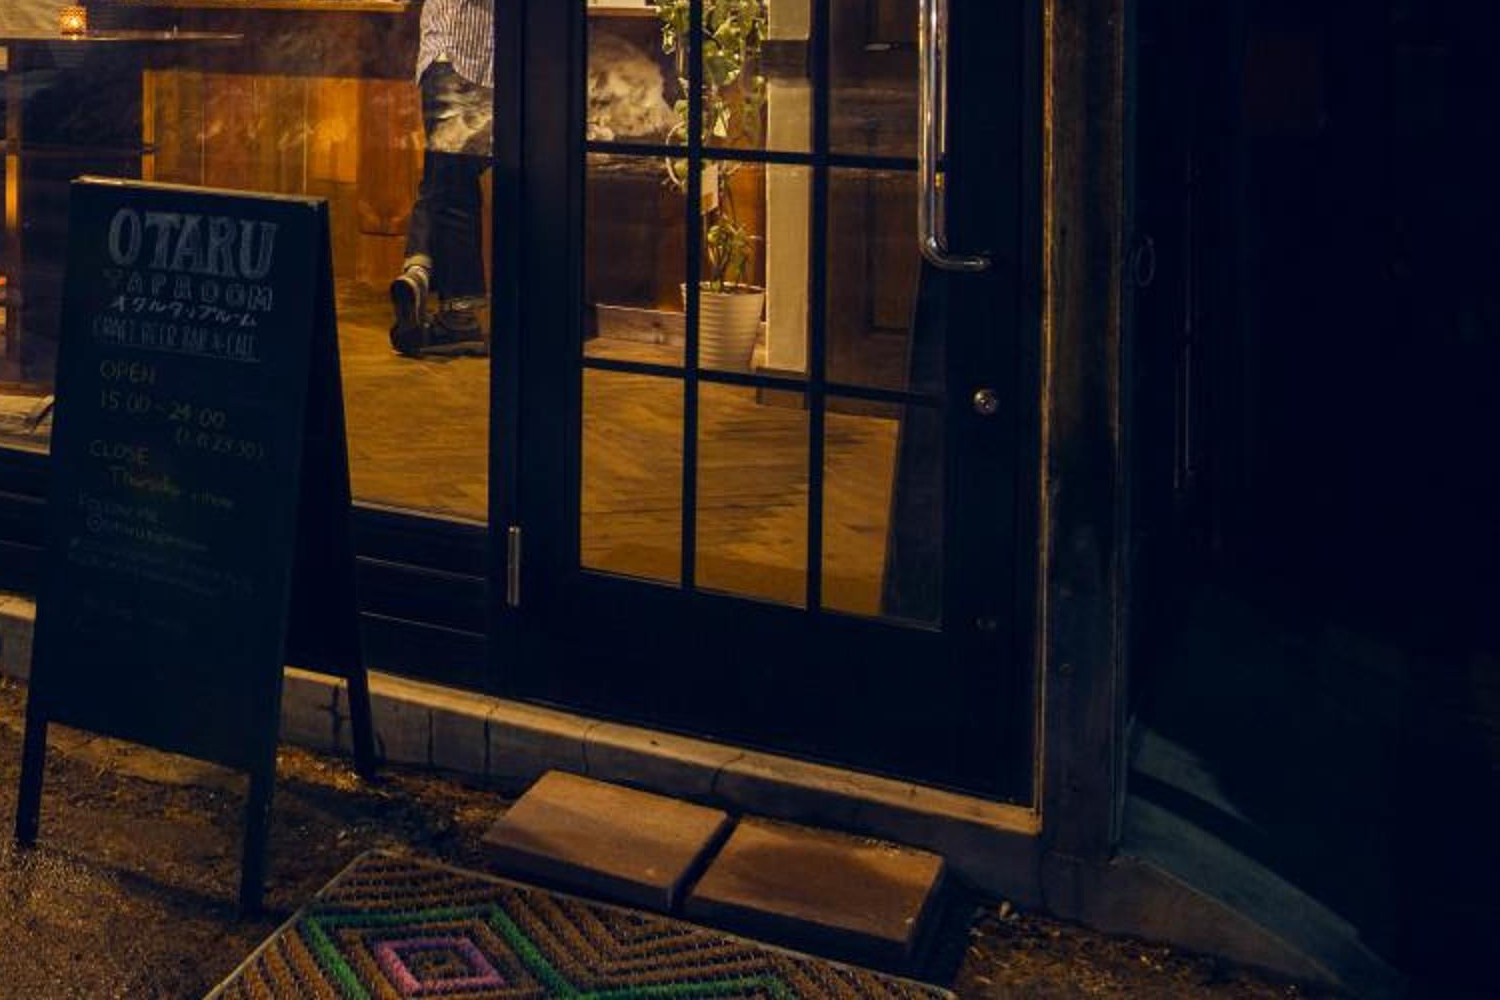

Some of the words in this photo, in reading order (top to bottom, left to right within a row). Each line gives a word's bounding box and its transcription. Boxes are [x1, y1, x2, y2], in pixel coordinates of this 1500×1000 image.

[108, 207, 280, 280] OTARU
[99, 359, 156, 386] OPEN
[88, 439, 149, 465] CLOSE
